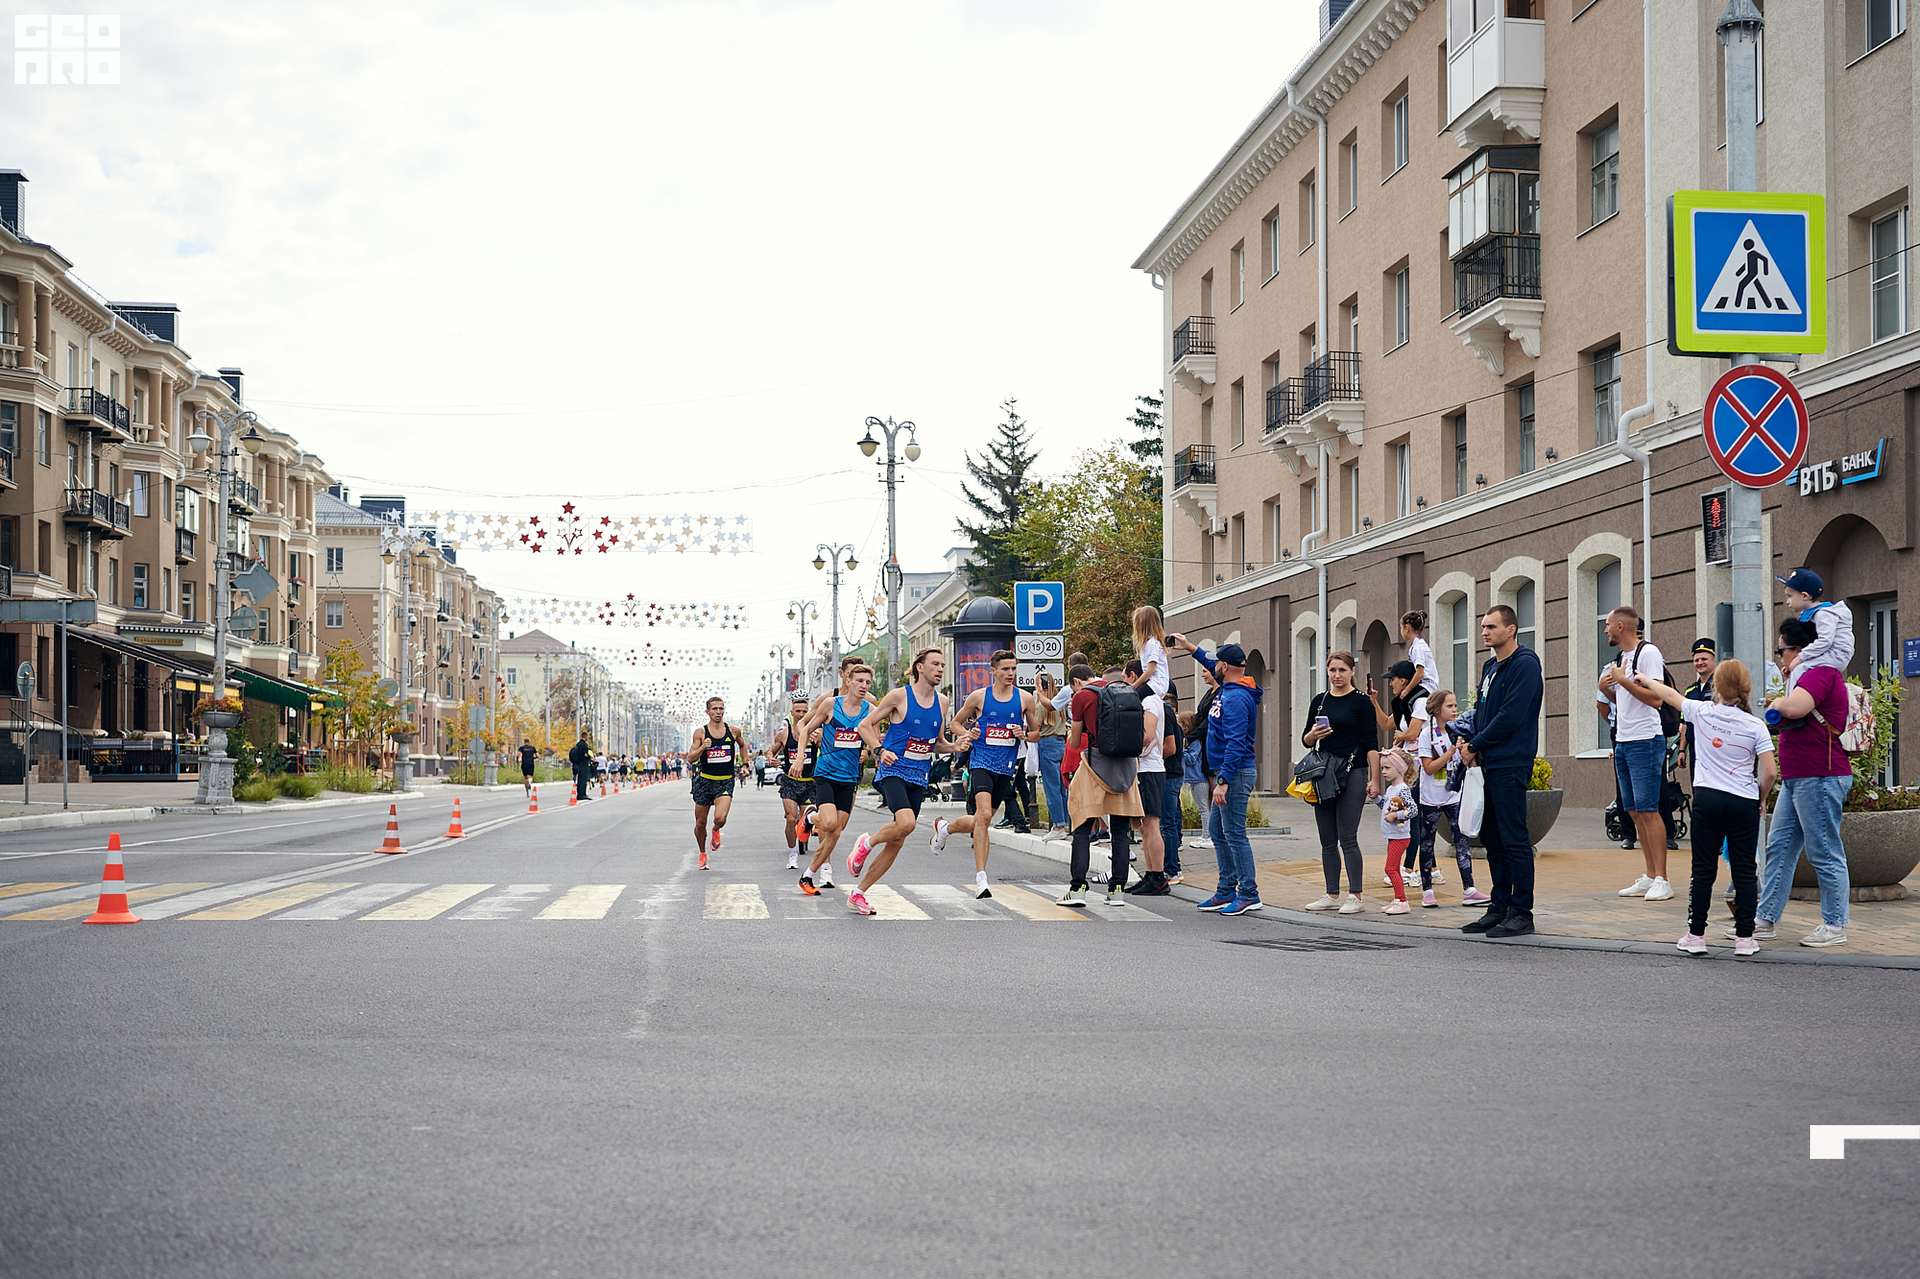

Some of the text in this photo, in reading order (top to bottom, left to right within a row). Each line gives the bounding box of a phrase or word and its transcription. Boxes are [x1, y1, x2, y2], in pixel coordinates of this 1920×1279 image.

[1800, 449, 1874, 497] ВТБ БАНК
[1028, 589, 1054, 626] P
[1032, 643, 1041, 651] 15
[1045, 642, 1057, 651] 20
[836, 732, 857, 741] 2327
[988, 729, 1010, 738] 2324
[908, 743, 931, 753] 2325
[708, 750, 726, 758] 2326
